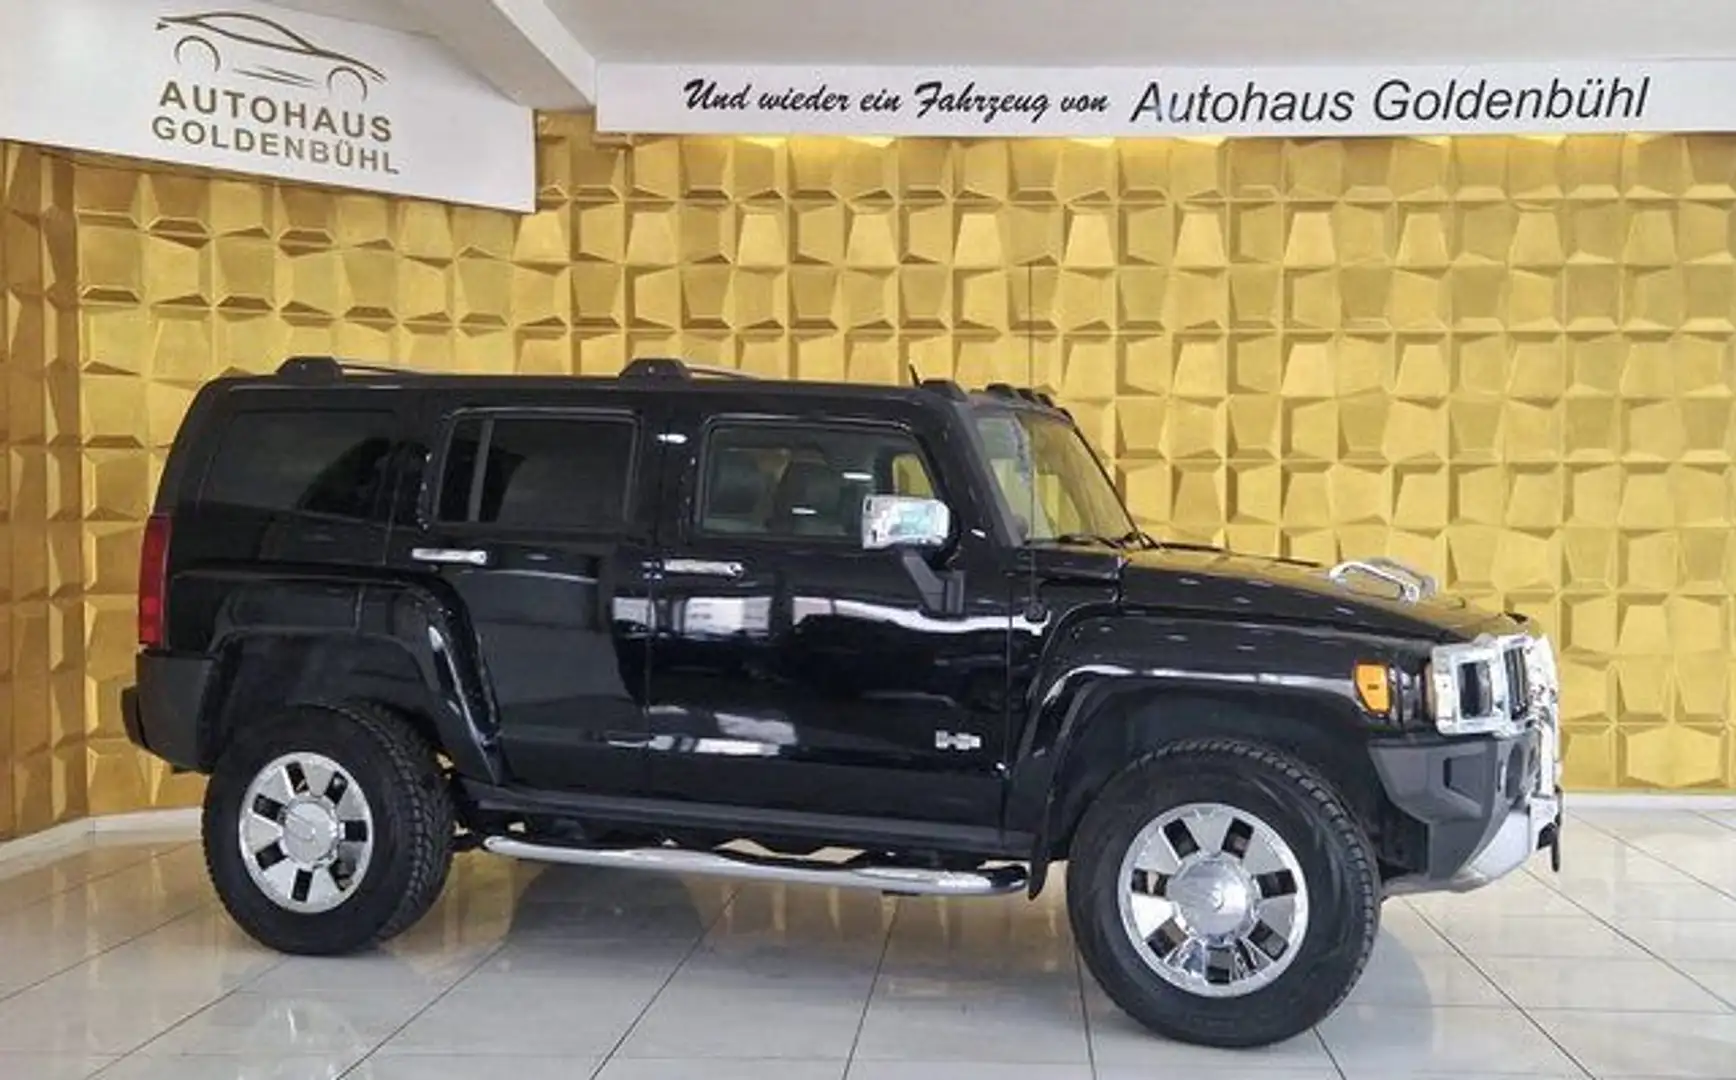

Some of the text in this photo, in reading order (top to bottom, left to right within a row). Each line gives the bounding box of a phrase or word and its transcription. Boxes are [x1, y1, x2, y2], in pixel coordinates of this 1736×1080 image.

[159, 81, 392, 143] AUTOHAUS
[683, 76, 1650, 123] Und wieder ein Fahrzeug von Autohaus Goldenbühl
[152, 115, 400, 175] GOLDENBÜHL
